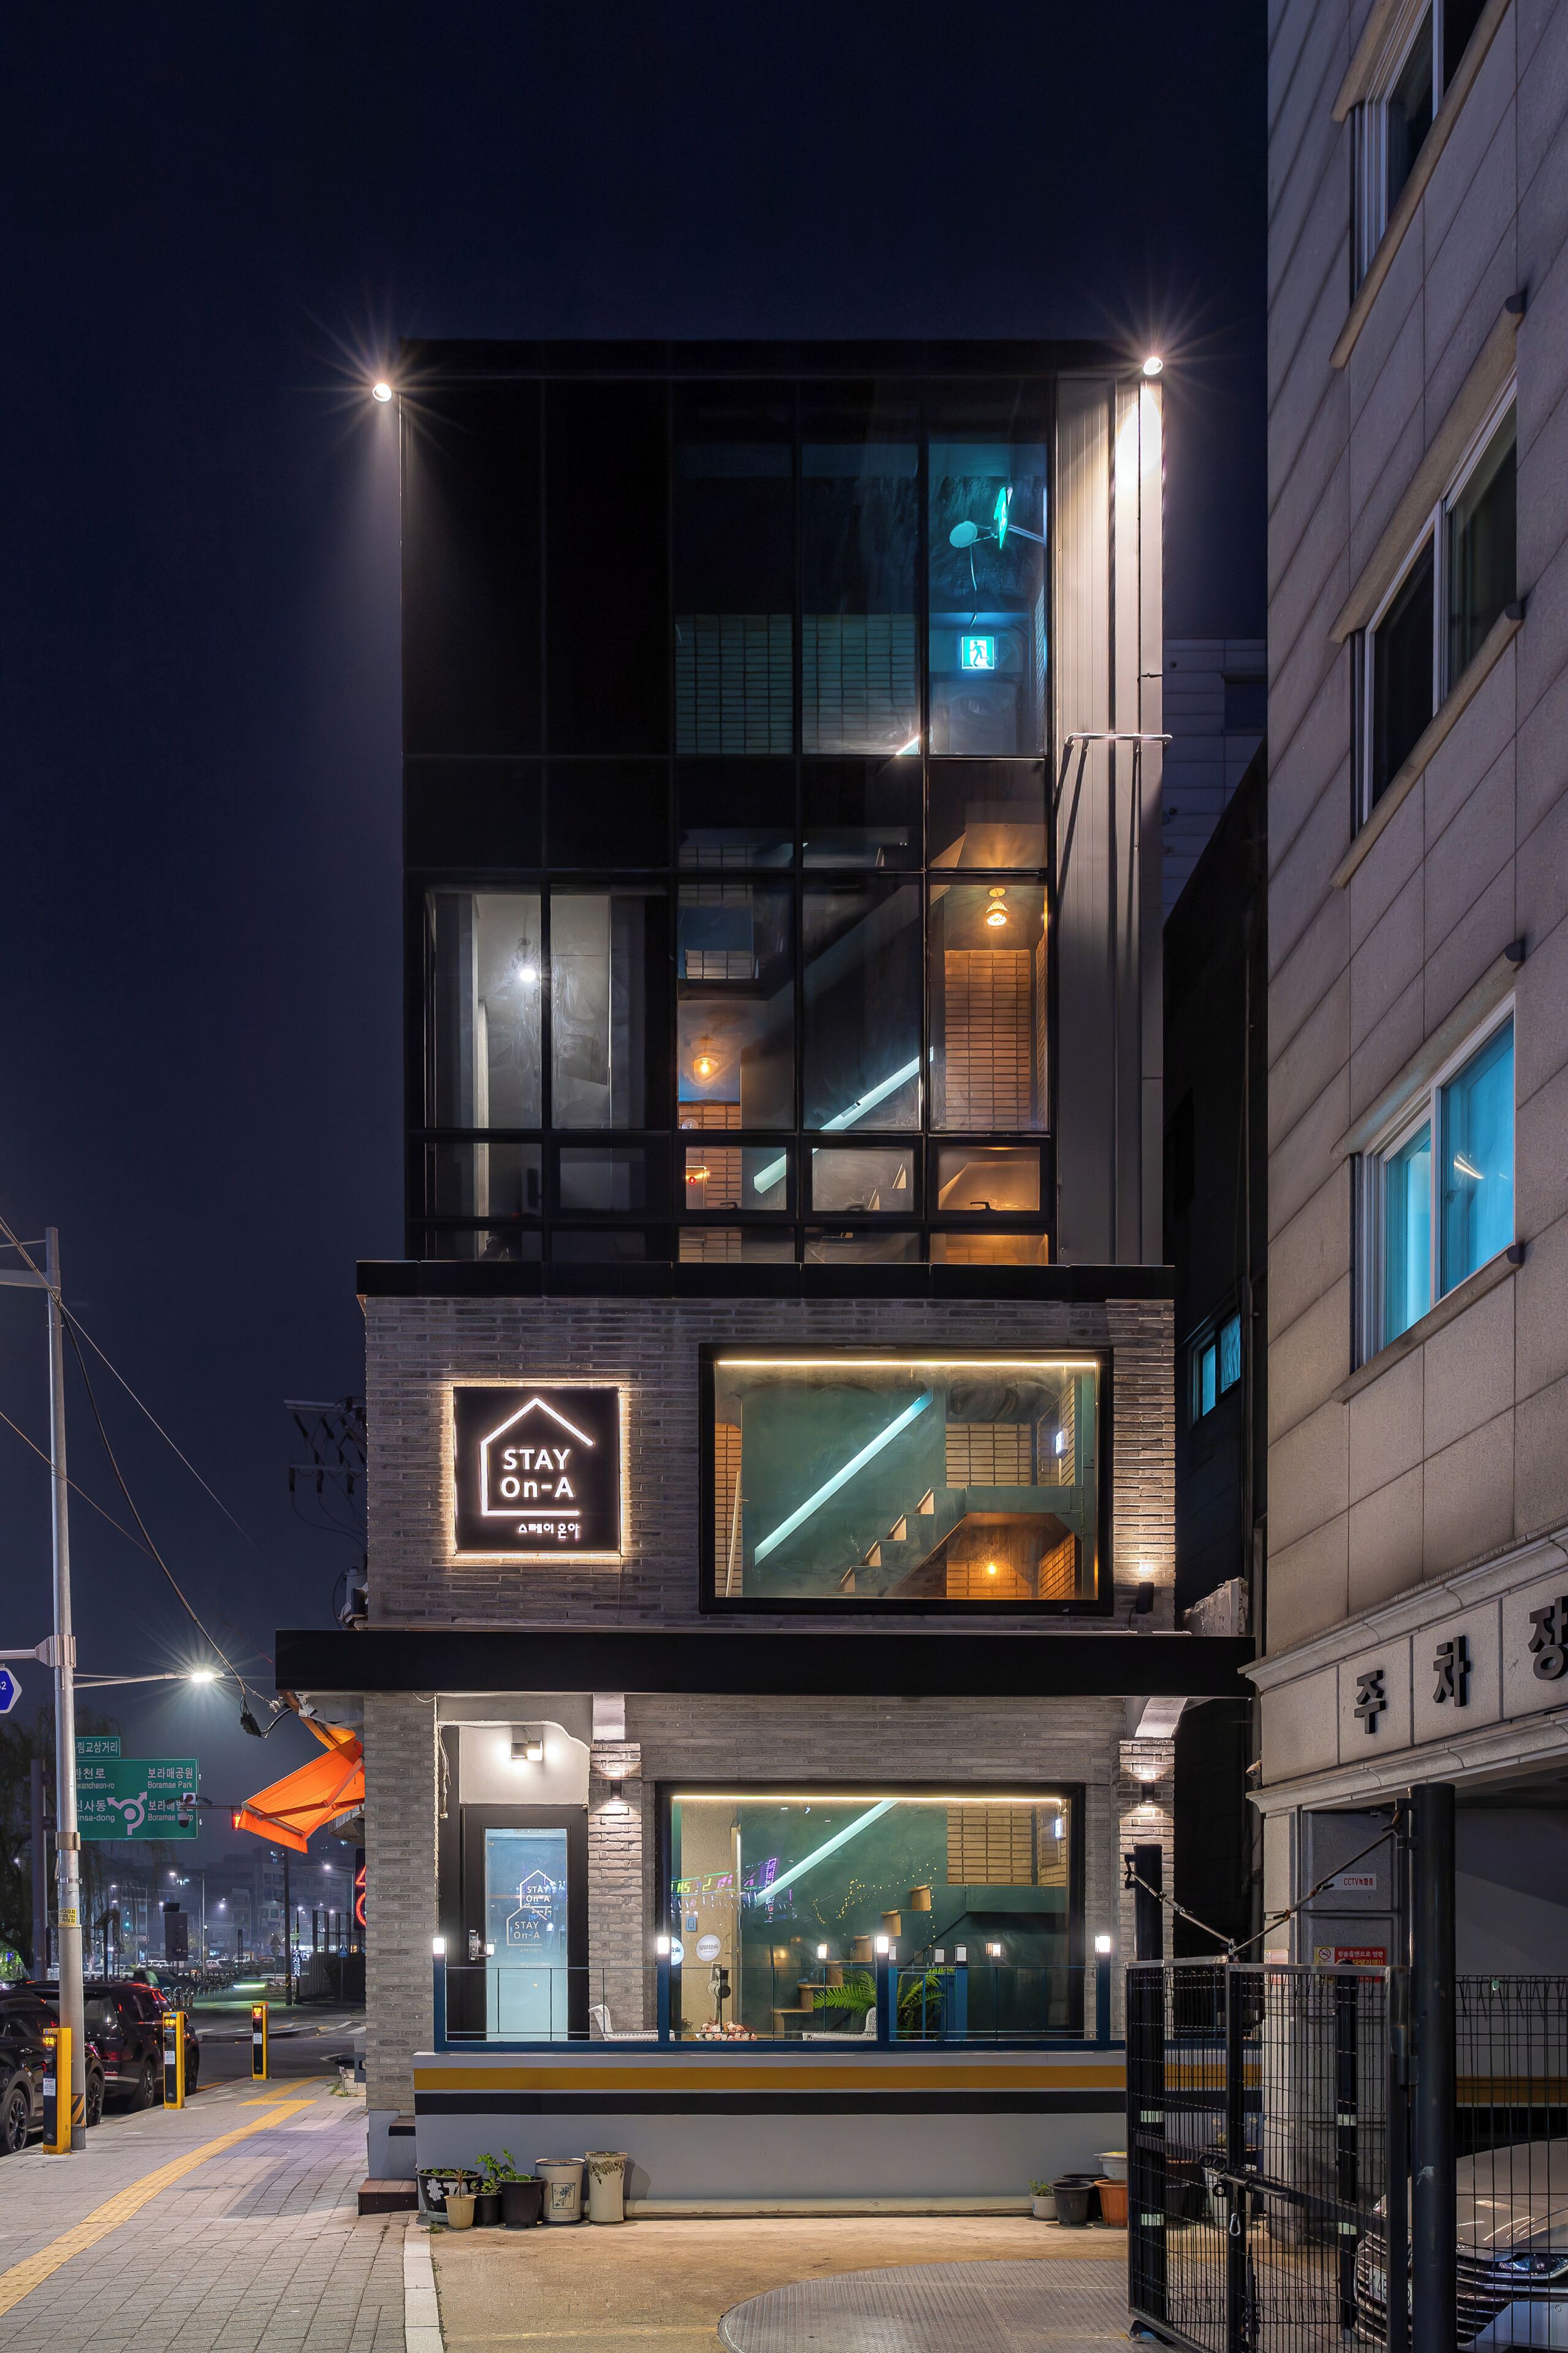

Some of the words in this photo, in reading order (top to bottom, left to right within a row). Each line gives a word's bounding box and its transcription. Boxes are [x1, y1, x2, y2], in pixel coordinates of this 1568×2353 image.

[504, 1449, 570, 1470] STAY
[501, 1476, 574, 1498] On-A
[558, 1523, 580, 1539] 온아
[1354, 1596, 1568, 1734] 주차장
[75, 1741, 118, 1753] 림교삼거리
[148, 1767, 193, 1779] 보라매공원
